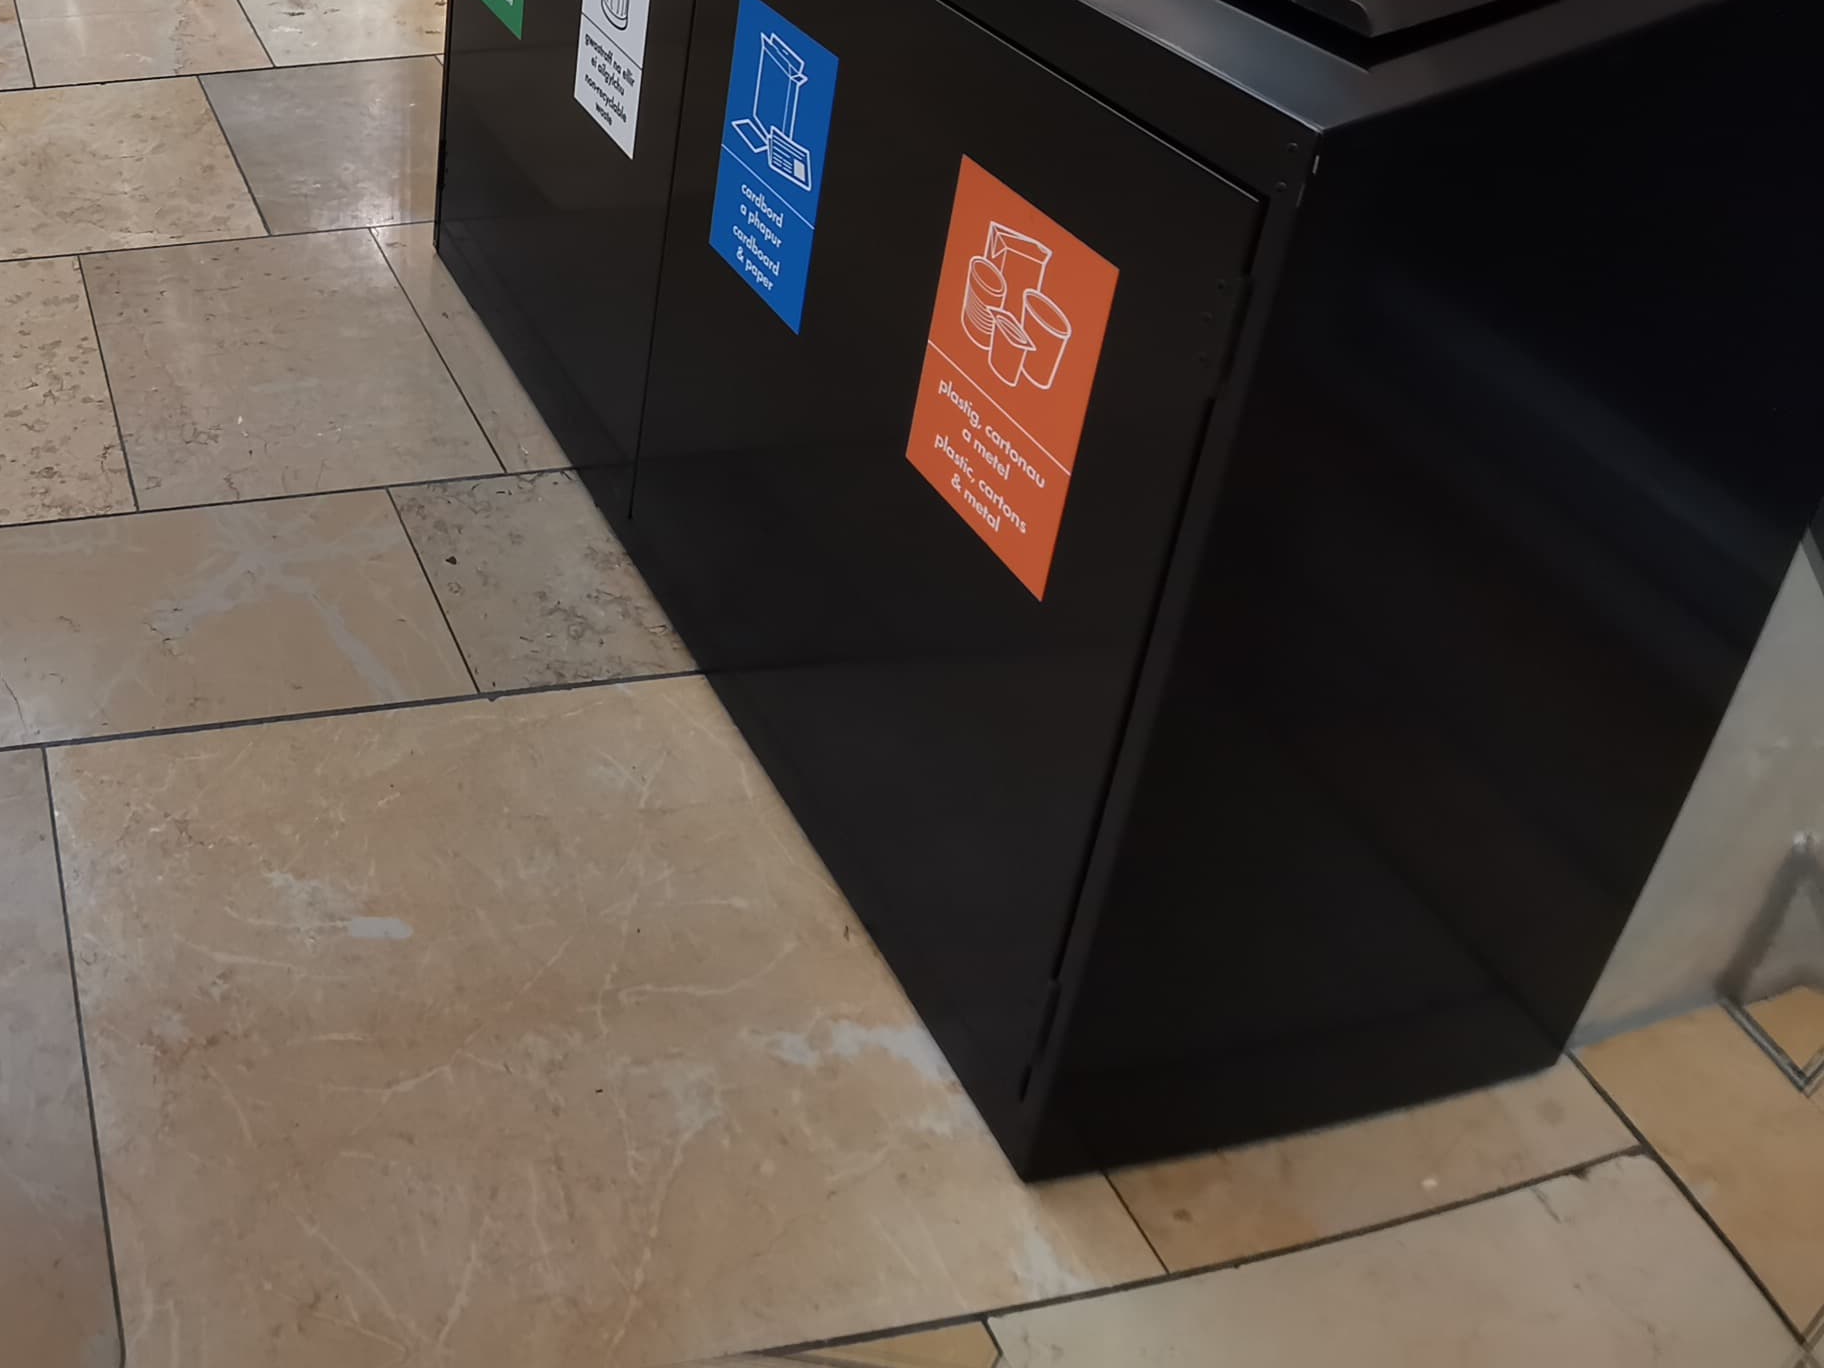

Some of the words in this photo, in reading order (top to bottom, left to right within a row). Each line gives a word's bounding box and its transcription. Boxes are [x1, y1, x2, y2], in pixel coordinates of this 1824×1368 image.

[584, 33, 613, 65] gwastraff
[584, 73, 627, 123] non-recyclable
[595, 103, 612, 126] waste
[740, 204, 747, 216] a
[747, 211, 782, 248] phapur
[741, 184, 784, 228] cardbord
[732, 225, 780, 277] cardboard
[736, 246, 745, 263] &
[744, 259, 774, 291] paper
[938, 379, 982, 429] plastig,
[985, 425, 1045, 489] cartonau
[962, 428, 972, 444] a
[973, 439, 1010, 480] metel
[934, 434, 975, 483] plastic,
[978, 479, 1027, 534] cartons
[951, 473, 962, 492] &
[963, 489, 1001, 532] metal
